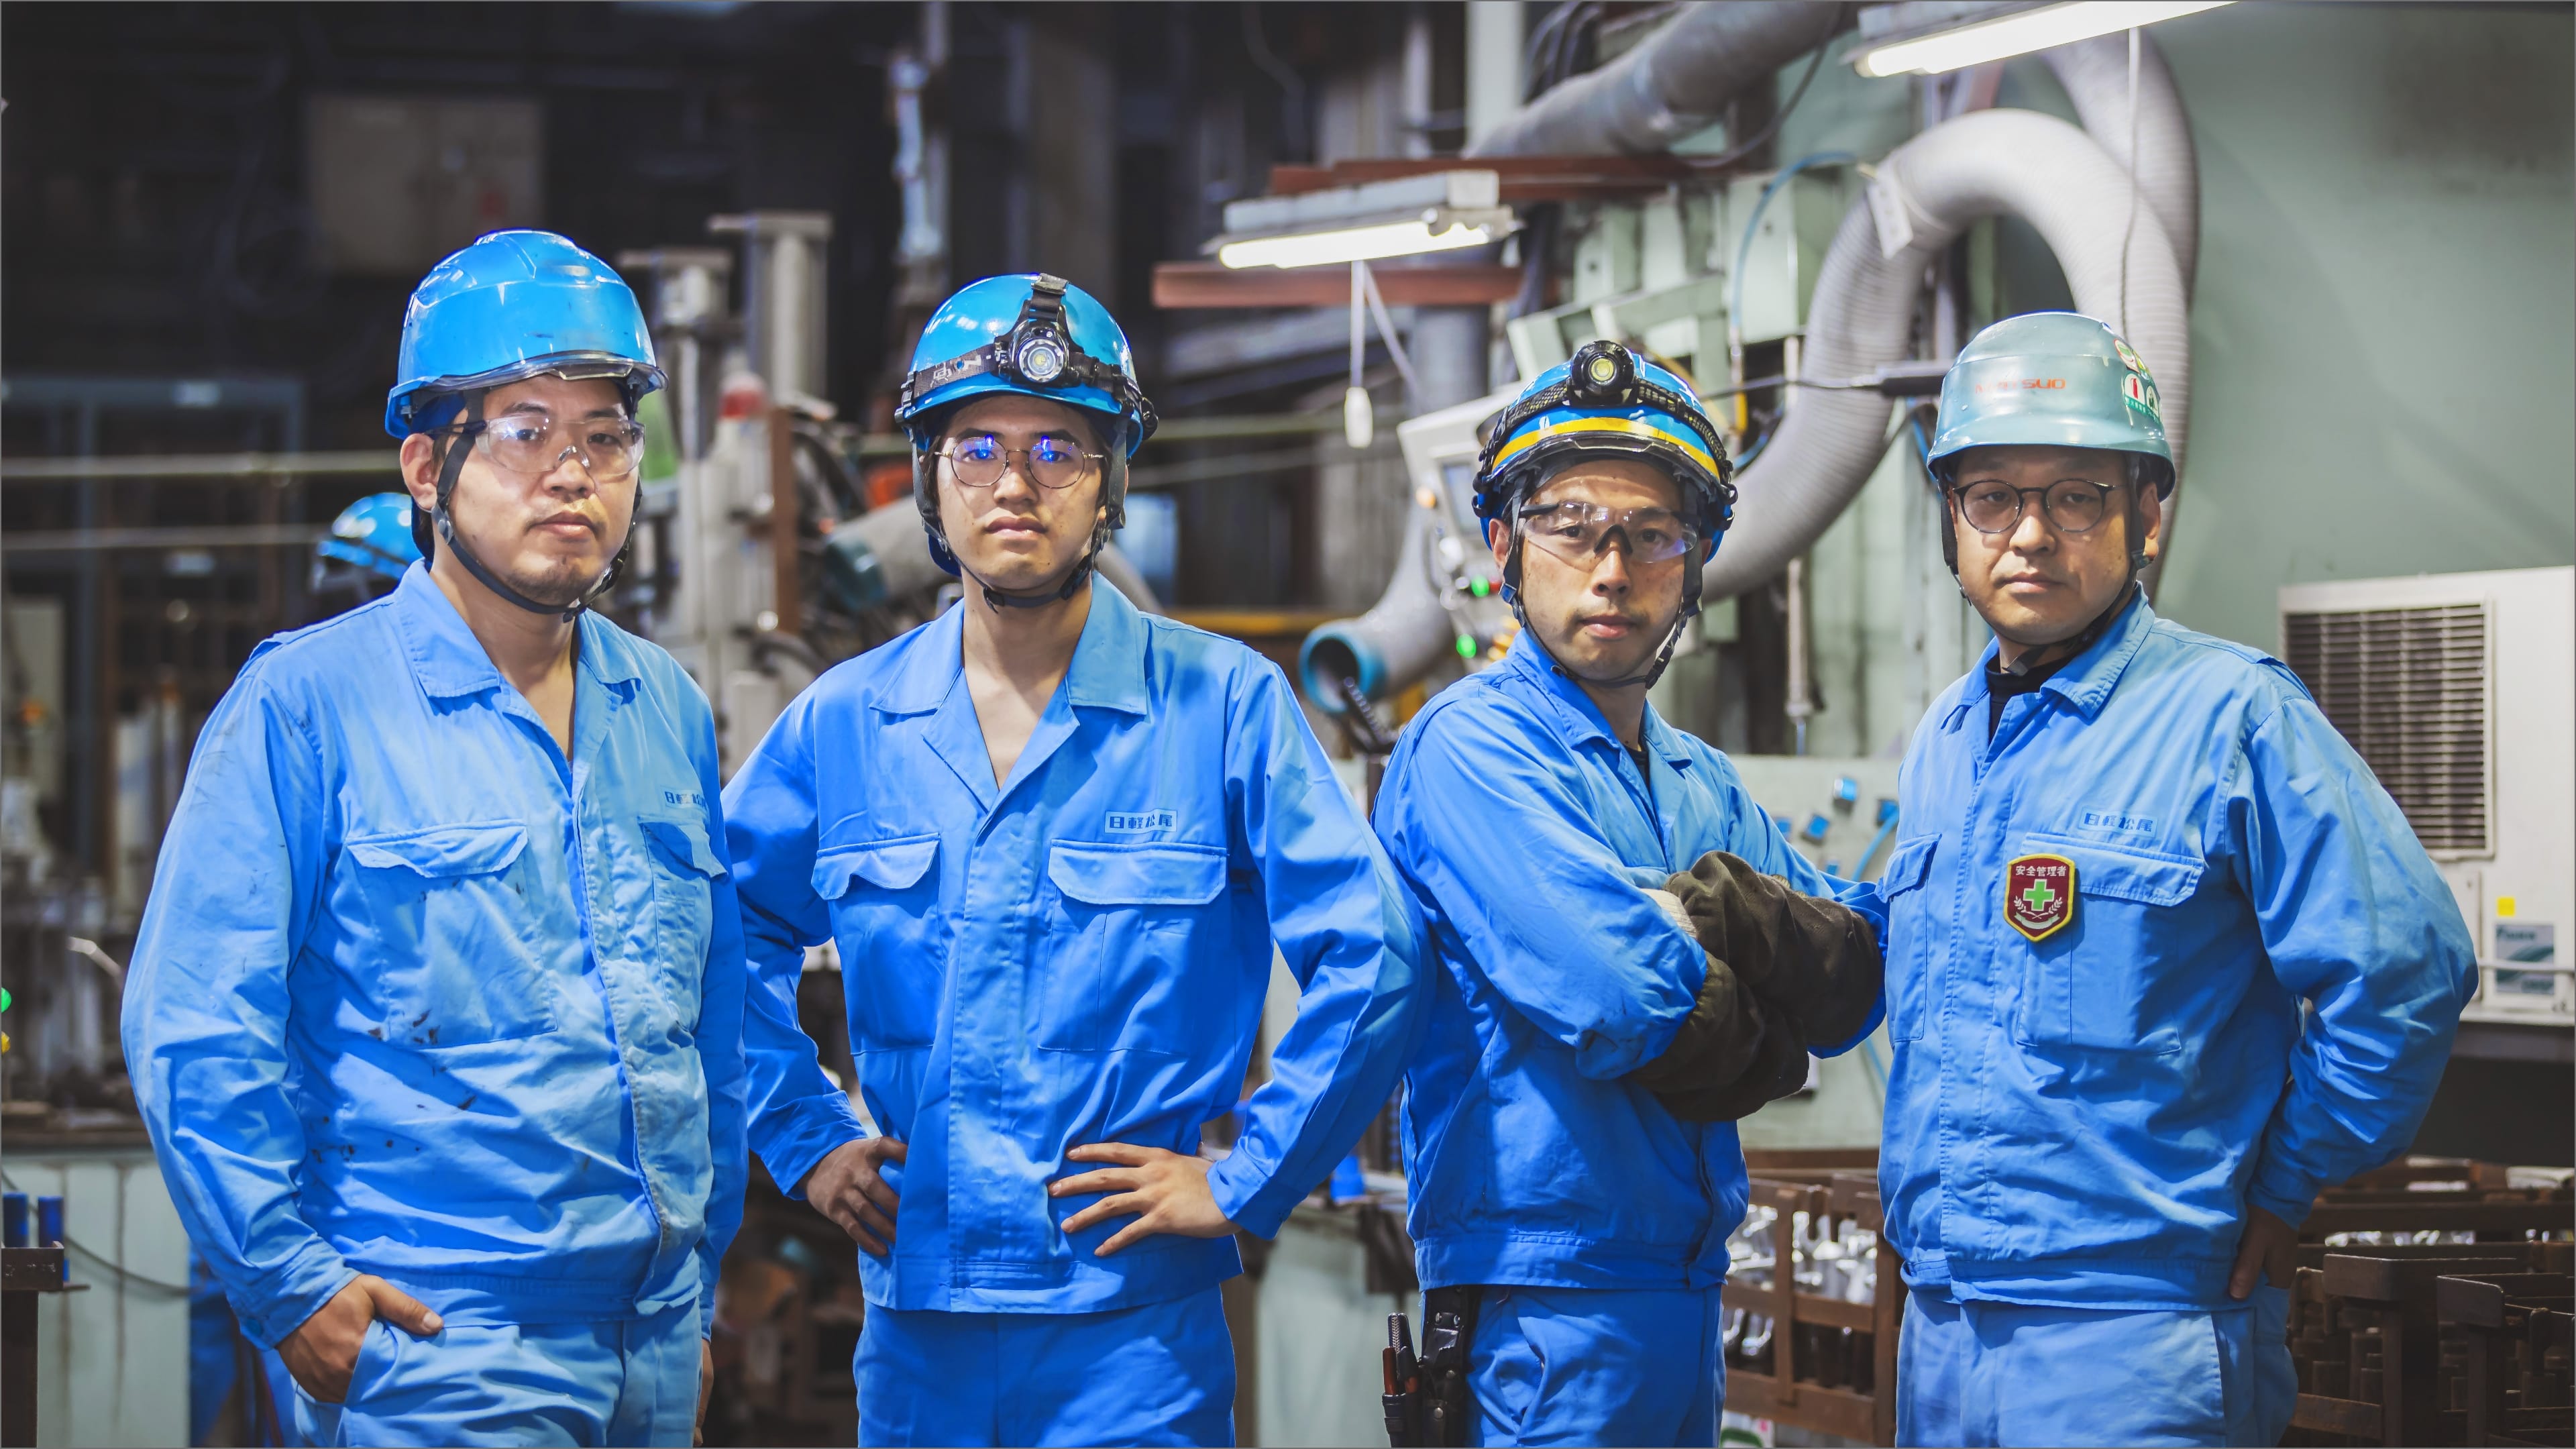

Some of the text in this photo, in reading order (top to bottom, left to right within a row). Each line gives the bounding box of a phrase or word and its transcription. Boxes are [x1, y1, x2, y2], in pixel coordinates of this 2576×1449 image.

[1109, 814, 1173, 829] 日軽松尾
[2084, 812, 2153, 832] 日軽松尾
[2015, 865, 2067, 877] 安全管理者
